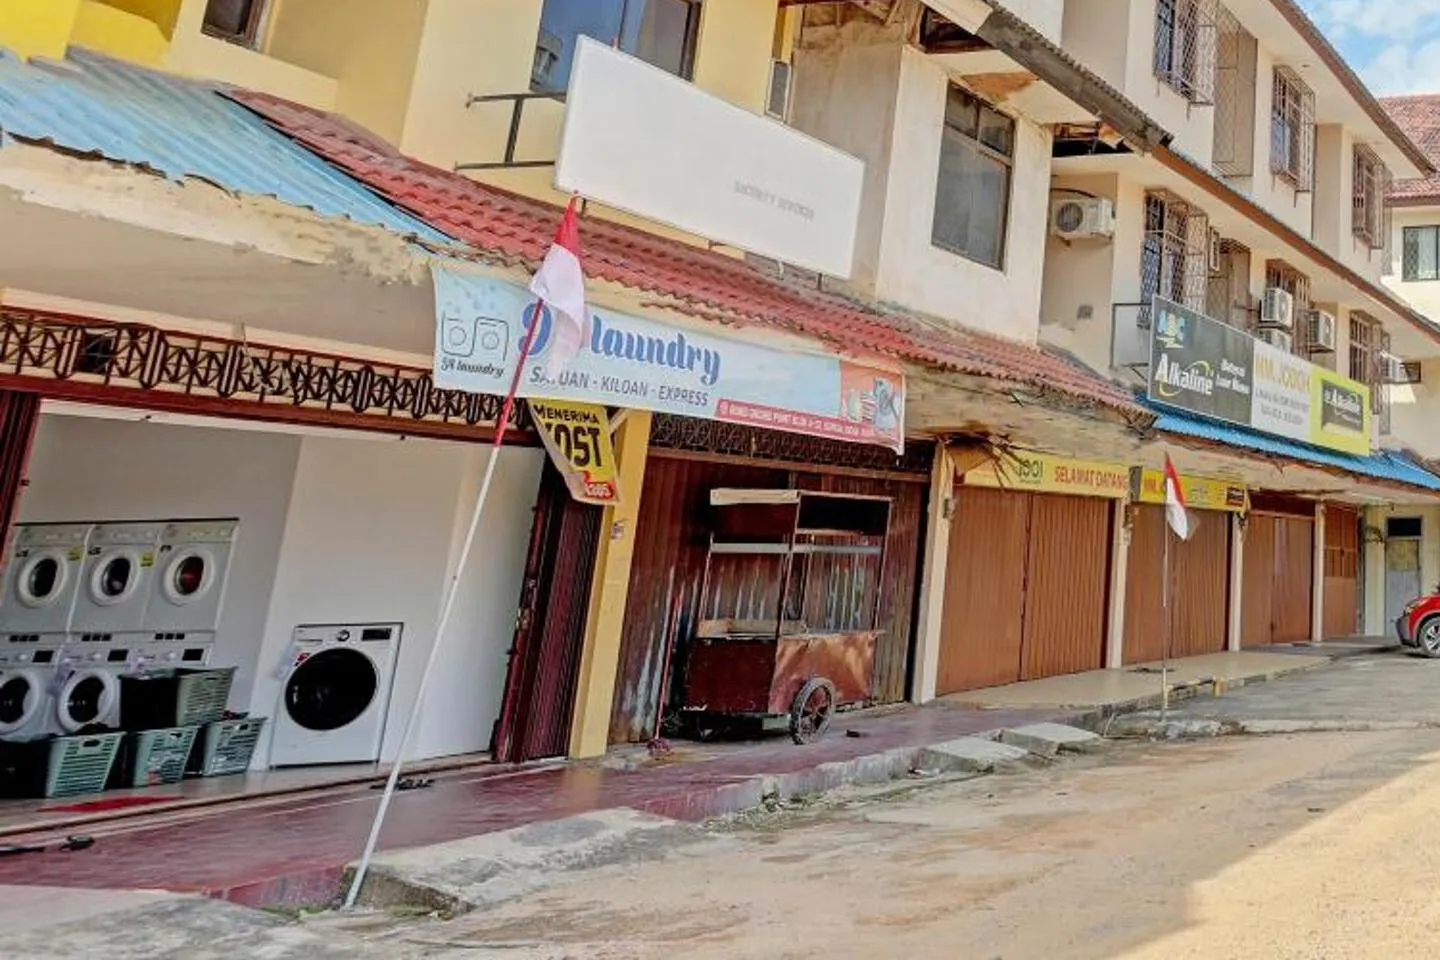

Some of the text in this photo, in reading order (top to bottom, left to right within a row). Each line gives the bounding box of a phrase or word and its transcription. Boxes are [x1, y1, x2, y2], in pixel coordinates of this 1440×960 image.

[591, 314, 721, 386] laundry
[601, 375, 649, 397] KILOAN
[658, 385, 709, 407] EXPRESS
[1154, 352, 1214, 396] Alkaline
[533, 404, 601, 425] MENERIMA
